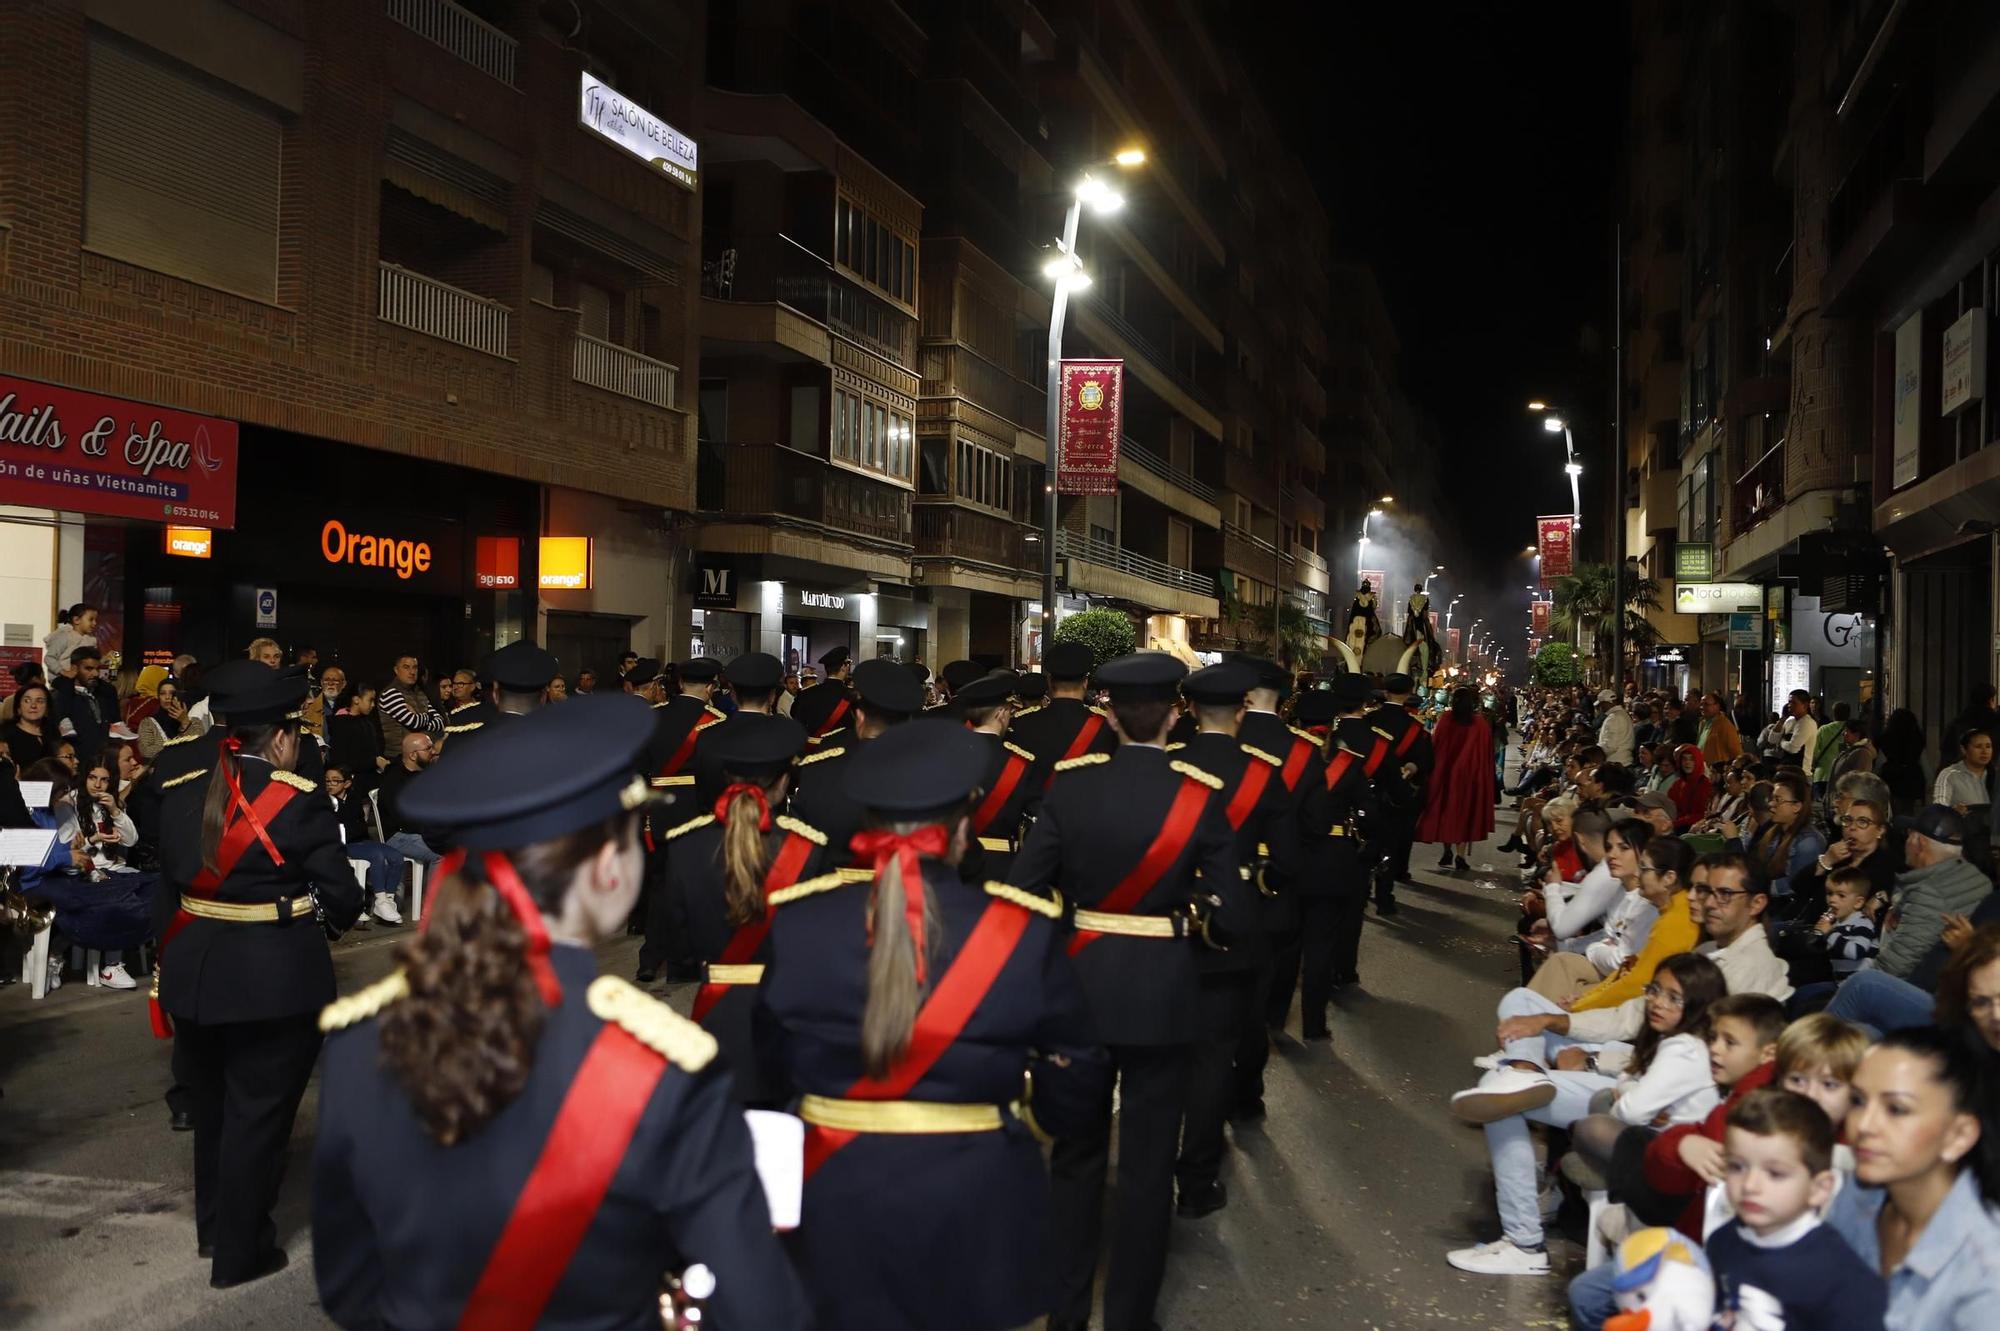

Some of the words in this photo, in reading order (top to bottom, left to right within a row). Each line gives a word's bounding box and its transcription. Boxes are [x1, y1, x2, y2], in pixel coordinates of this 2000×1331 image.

[611, 98, 645, 133] SALÓN
[648, 120, 660, 142] DE
[661, 130, 695, 164] BELLEZA
[80, 416, 116, 456] &
[124, 421, 192, 475] Spa
[25, 464, 45, 479] de
[53, 468, 90, 485] uñas
[96, 474, 178, 497] Vietnamita
[173, 506, 188, 517] 675
[188, 508, 198, 518] 32
[172, 540, 208, 555] orange
[321, 520, 431, 579] Orange
[541, 575, 581, 587] orange
[701, 568, 730, 595] M
